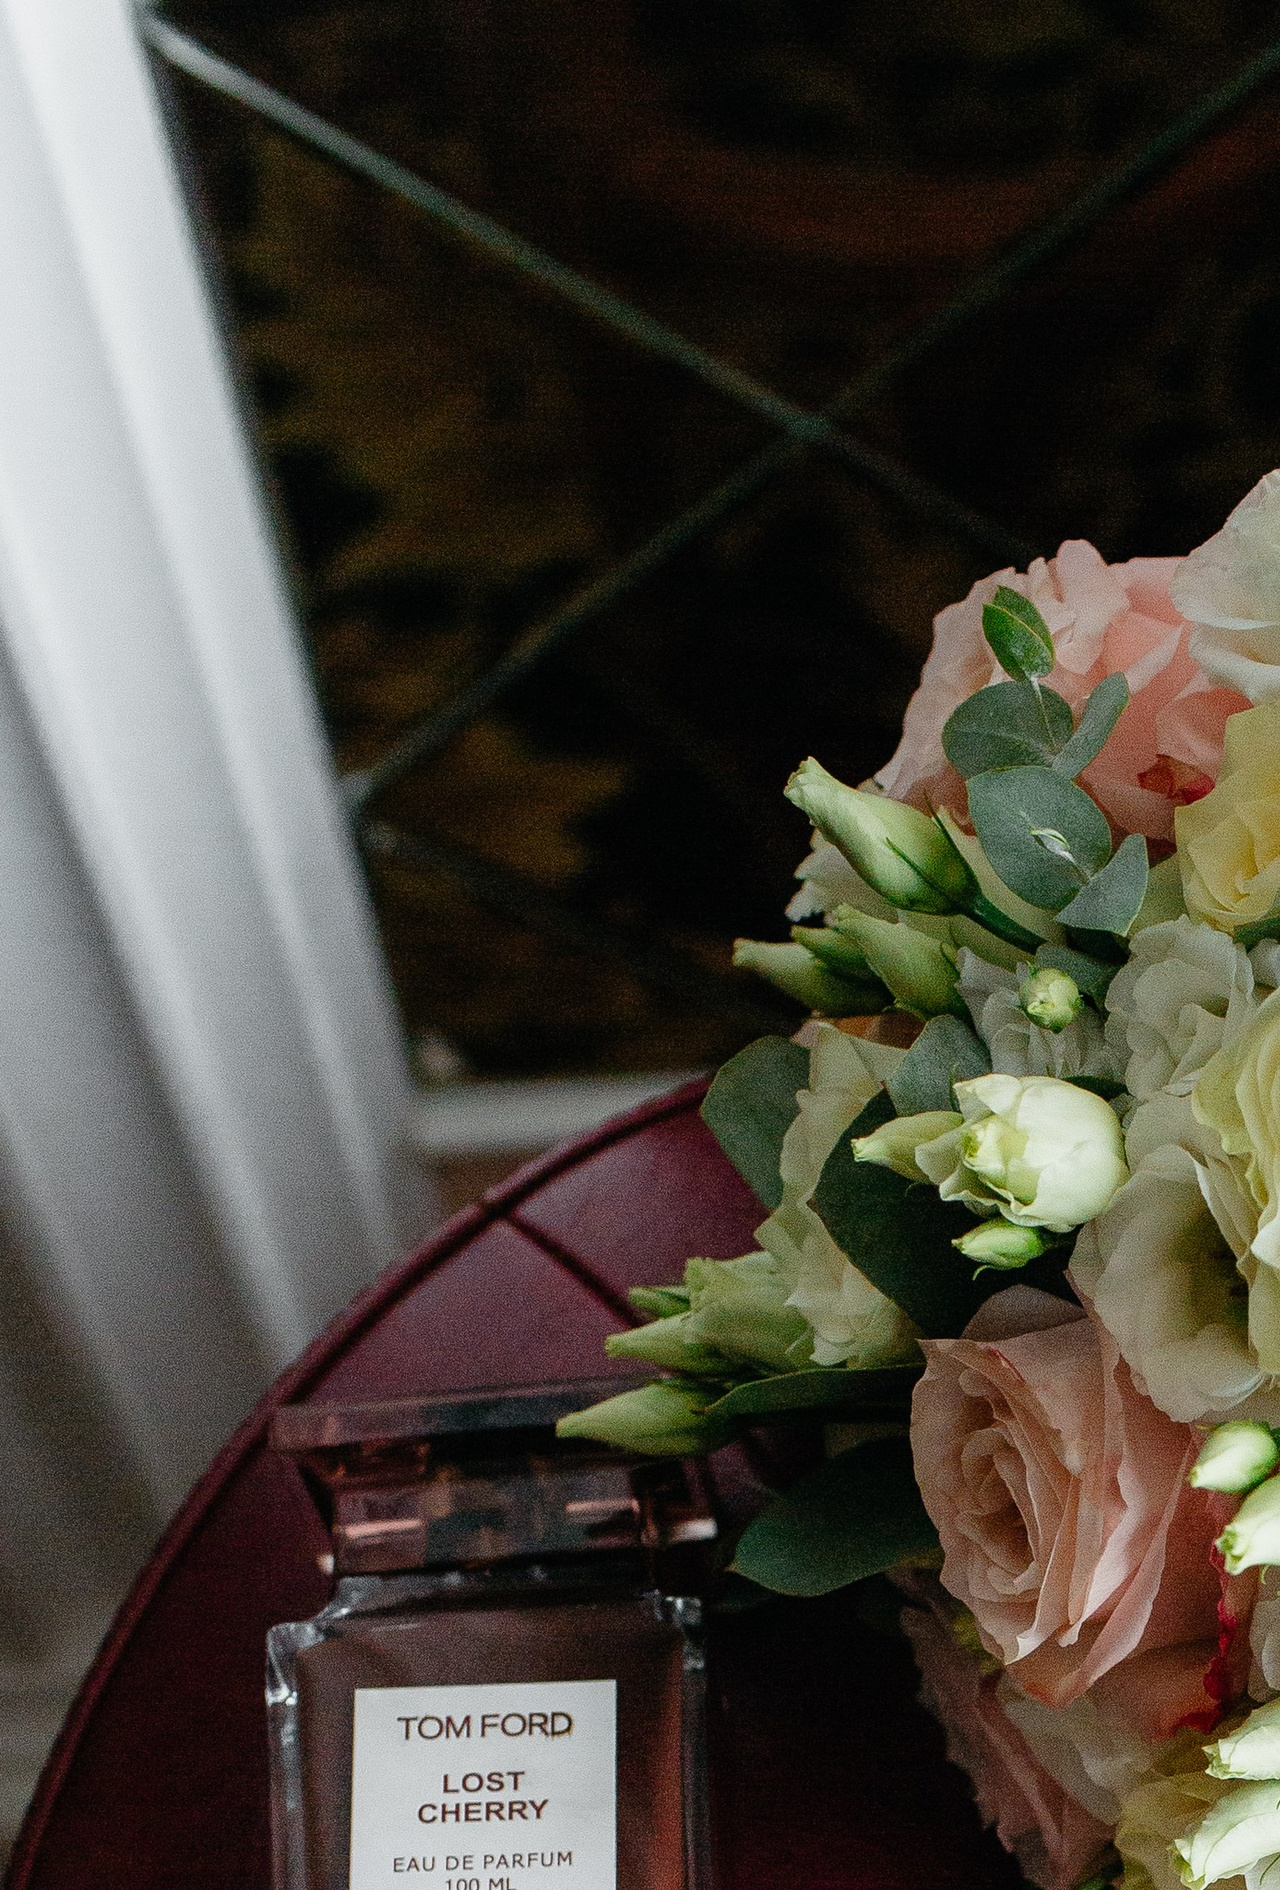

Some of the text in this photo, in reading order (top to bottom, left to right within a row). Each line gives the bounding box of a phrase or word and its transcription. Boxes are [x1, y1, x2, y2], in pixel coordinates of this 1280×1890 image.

[396, 1711, 574, 1741] TOM FORD
[442, 1770, 525, 1794] LOST
[417, 1799, 549, 1824] CHERRY
[392, 1850, 573, 1873] EAU DE PARFUM
